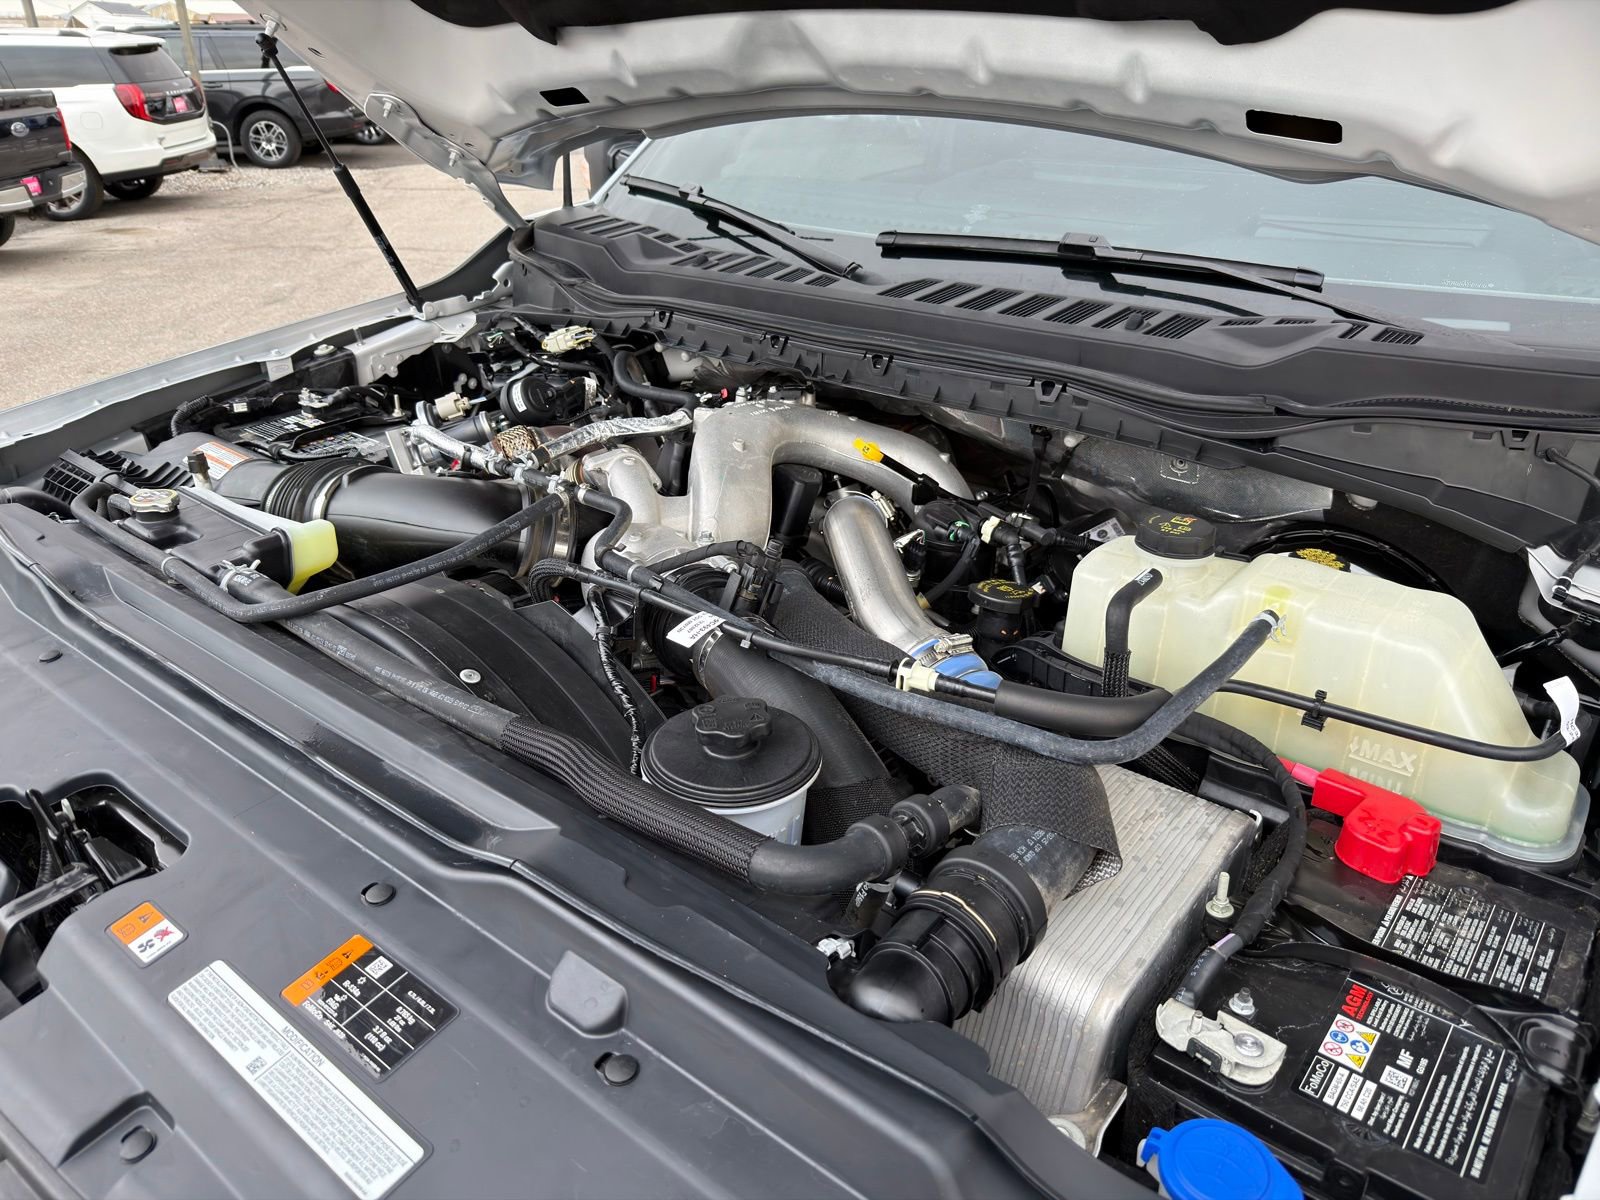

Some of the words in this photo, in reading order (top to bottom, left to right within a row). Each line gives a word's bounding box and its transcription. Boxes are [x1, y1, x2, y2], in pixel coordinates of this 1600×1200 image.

[1360, 739, 1416, 771] MAX
[343, 979, 361, 996] R-134a
[1340, 983, 1366, 1016] AGM
[326, 997, 339, 1009] PAG
[1358, 991, 1374, 1020] TECHNOLOGY
[281, 1025, 326, 1067] MODIFICATION
[1396, 1048, 1414, 1068] MF
[1305, 1059, 1330, 1094] FoMoCo
